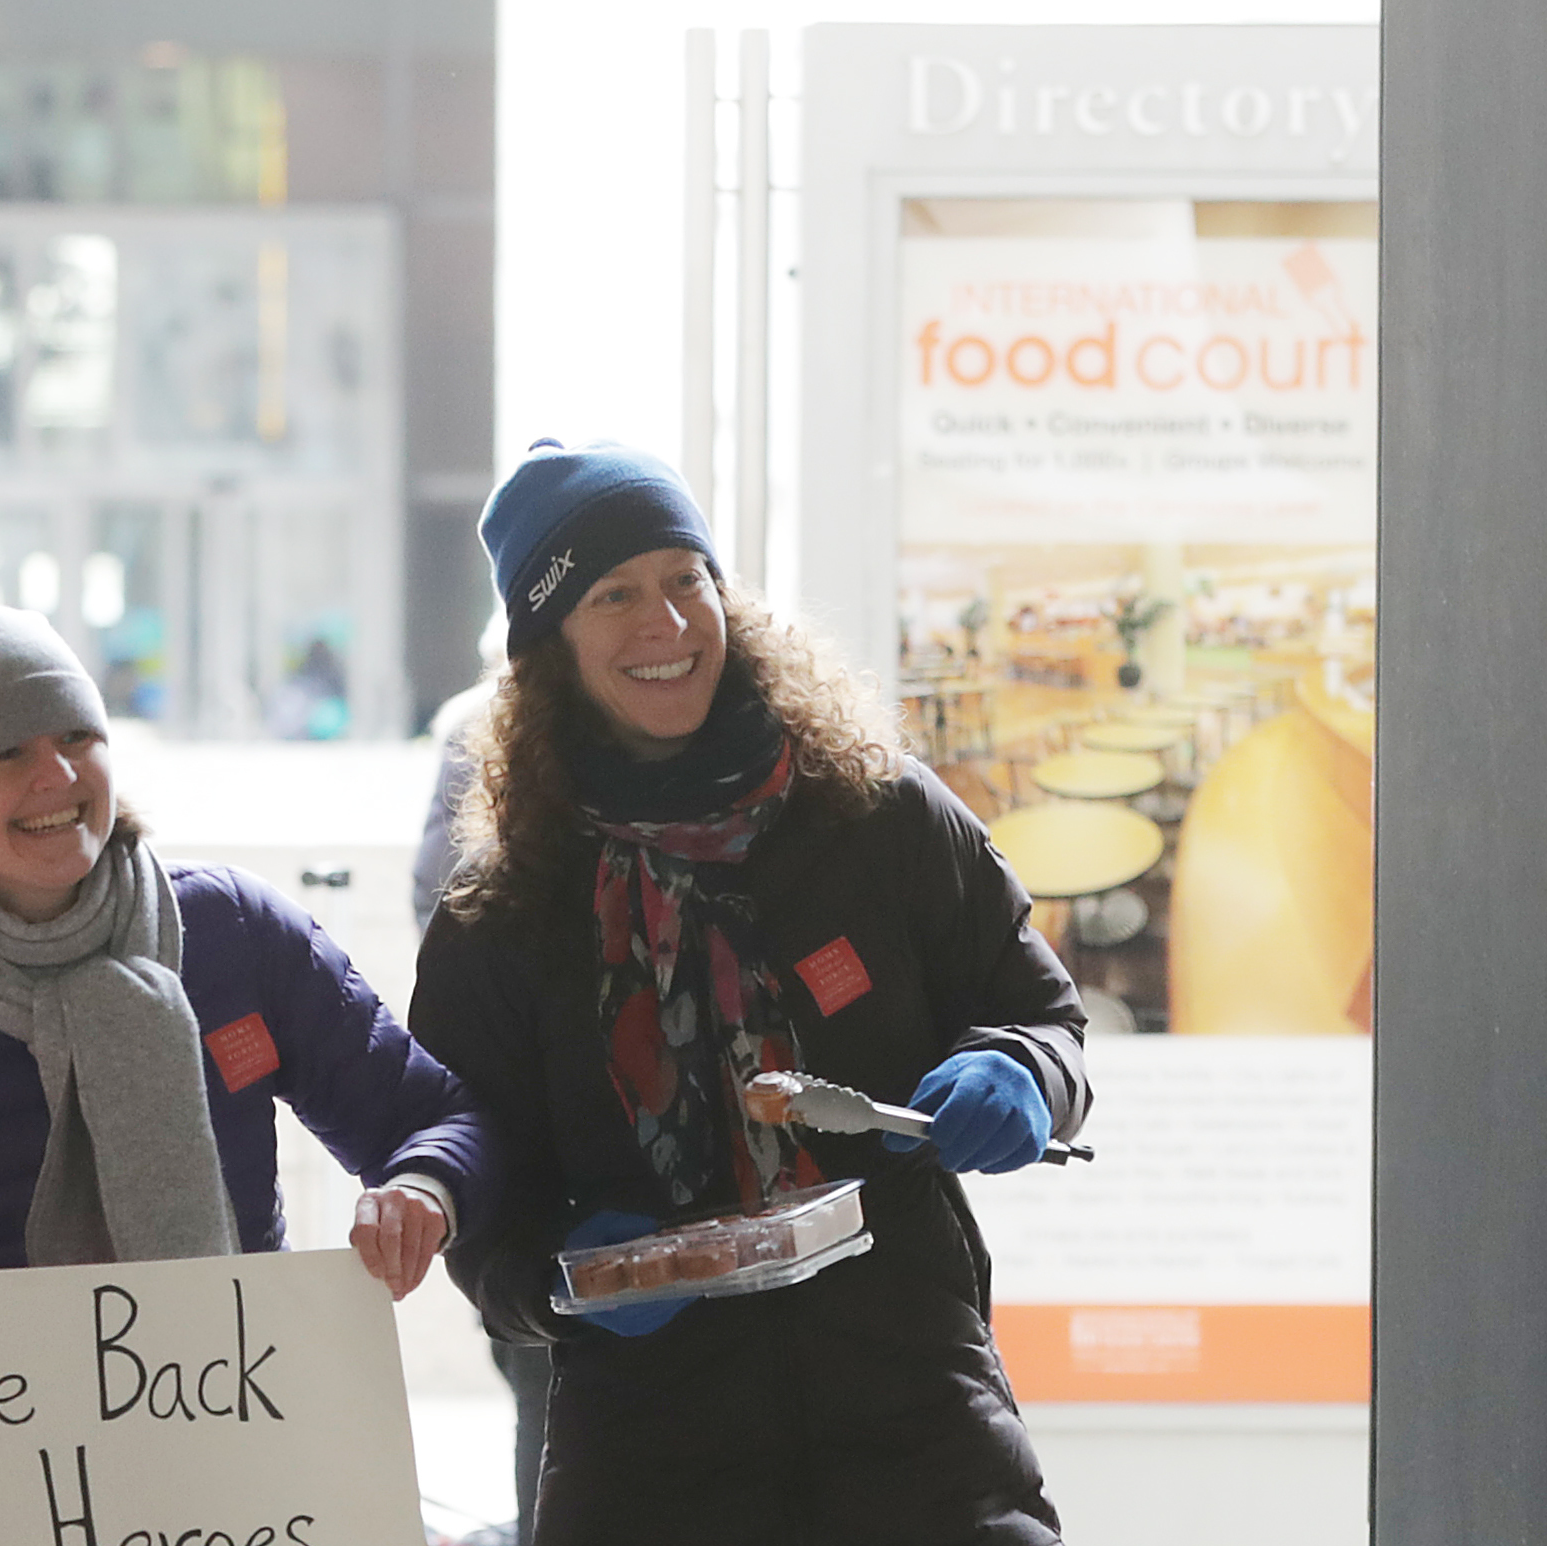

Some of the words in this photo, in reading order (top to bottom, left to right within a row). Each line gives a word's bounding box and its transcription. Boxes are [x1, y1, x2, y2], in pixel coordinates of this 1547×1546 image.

[907, 54, 1379, 166] Directory
[950, 277, 1291, 320] INTERNATIONAL
[913, 319, 1119, 390] food
[1135, 322, 1368, 392] court
[931, 409, 1012, 438] Quick
[1046, 409, 1211, 437] Convenient
[1242, 409, 1350, 437] Diverse
[93, 1279, 284, 1423] Back
